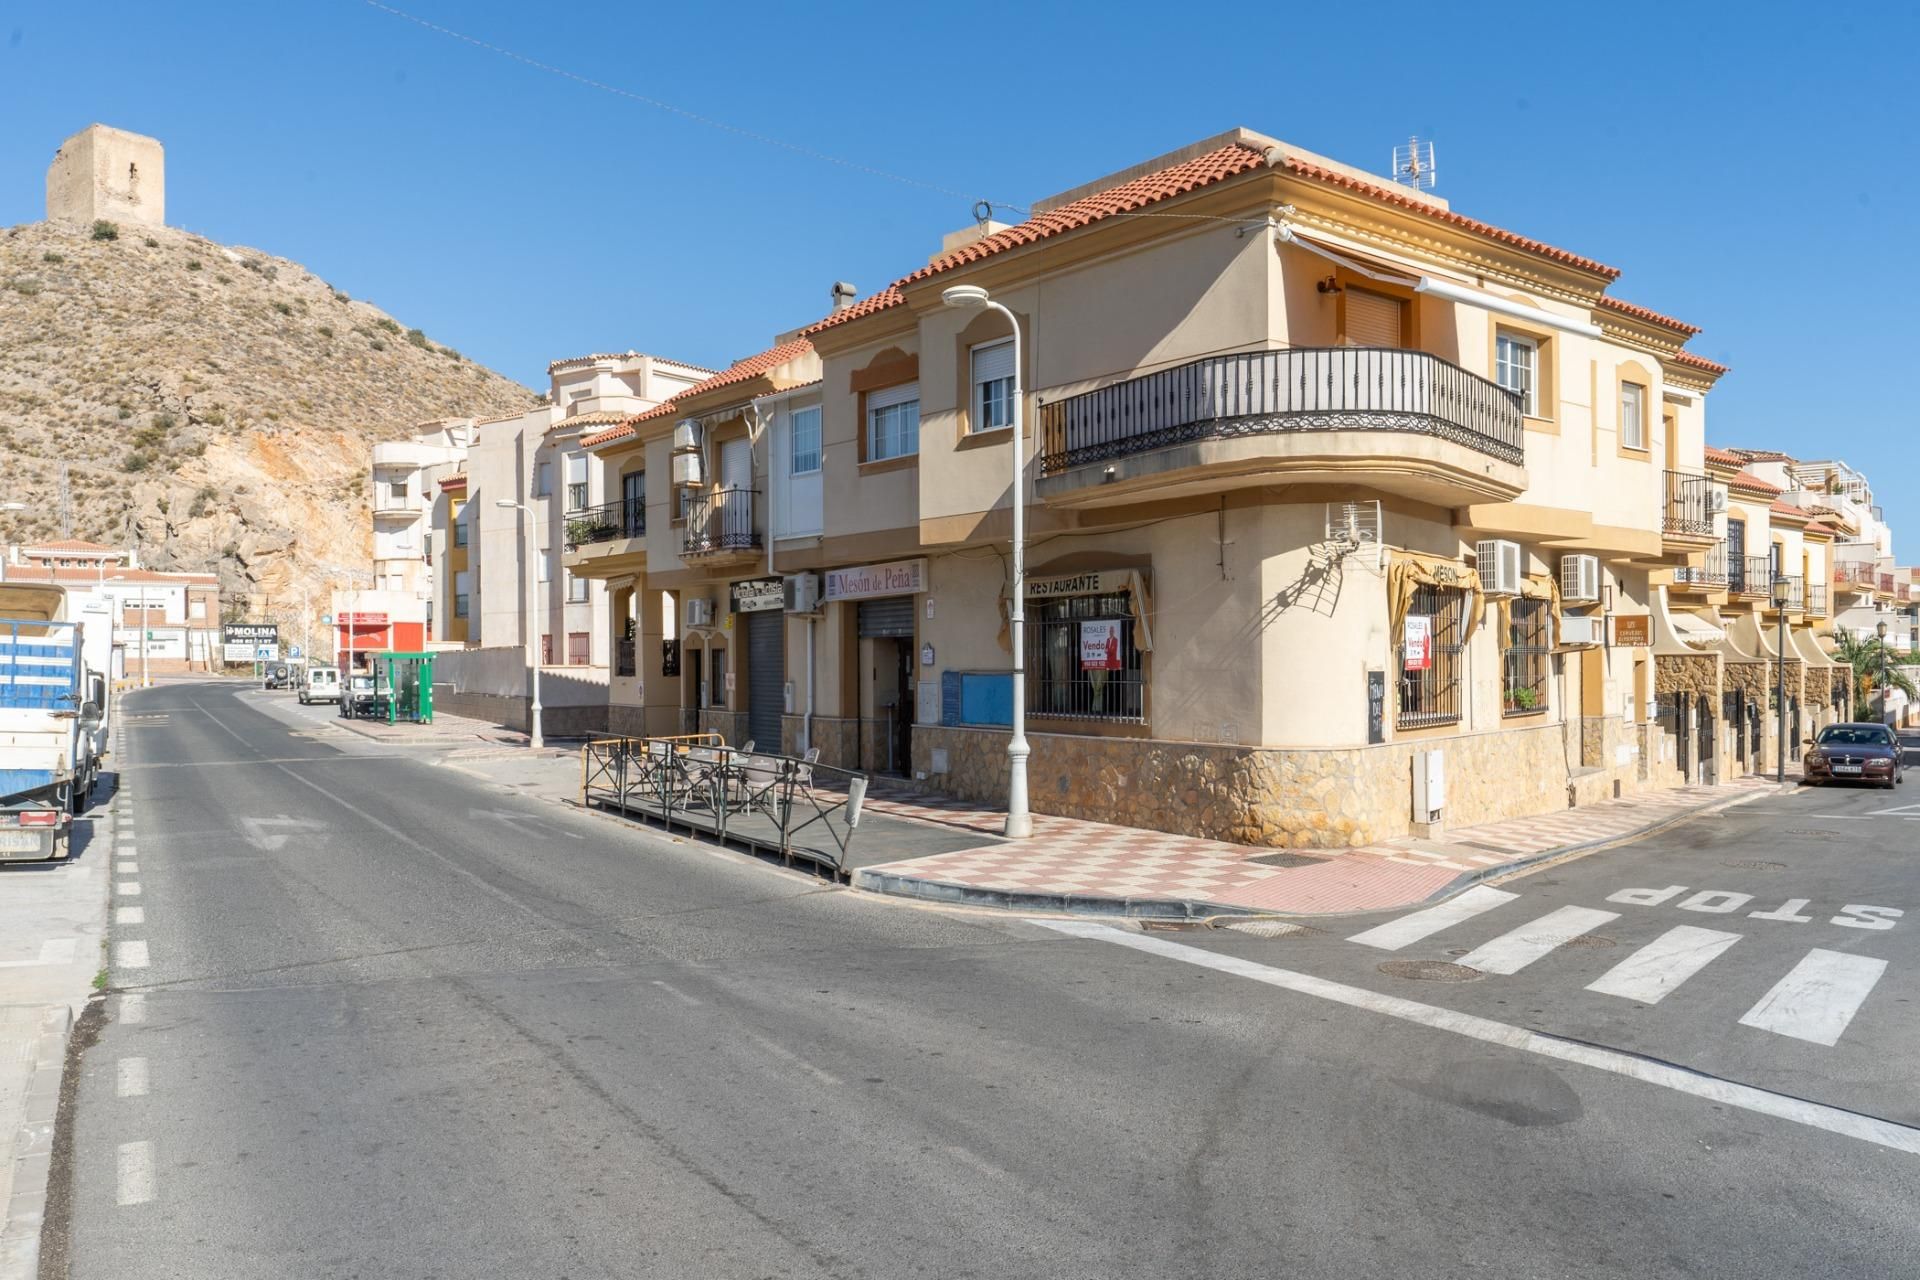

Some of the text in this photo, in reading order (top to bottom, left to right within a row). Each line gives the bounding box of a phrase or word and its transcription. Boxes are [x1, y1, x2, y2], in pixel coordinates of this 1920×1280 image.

[838, 567, 910, 594] Mesón de Peña
[1030, 575, 1099, 595] RESTAURANTE
[234, 627, 276, 636] MOLINA
[1083, 625, 1106, 634] ROSALES
[1083, 640, 1106, 651] Vendo
[1605, 885, 1905, 930] STOP
